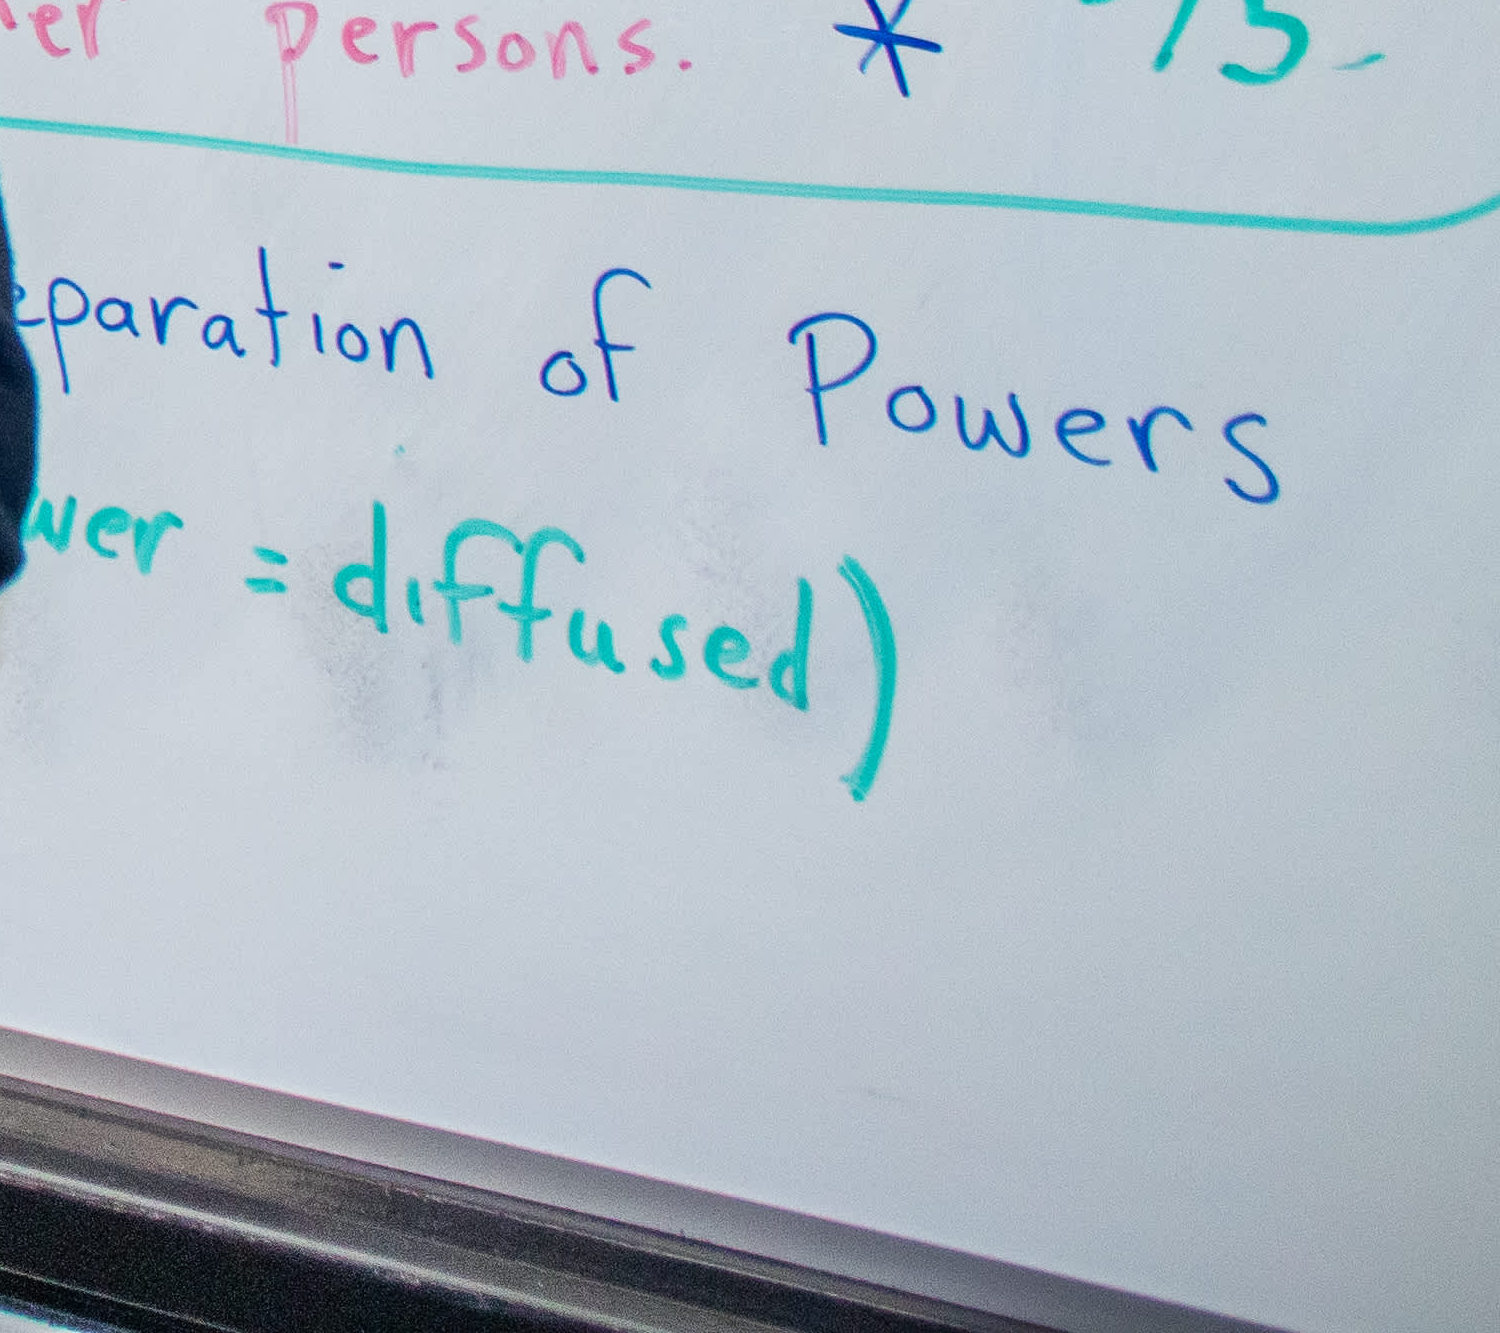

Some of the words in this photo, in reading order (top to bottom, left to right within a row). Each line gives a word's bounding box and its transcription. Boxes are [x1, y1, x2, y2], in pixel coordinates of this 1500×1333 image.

[11, 245, 437, 395] eparation
[538, 267, 654, 405] of
[787, 309, 1285, 506] Powers
[21, 484, 185, 577] wer
